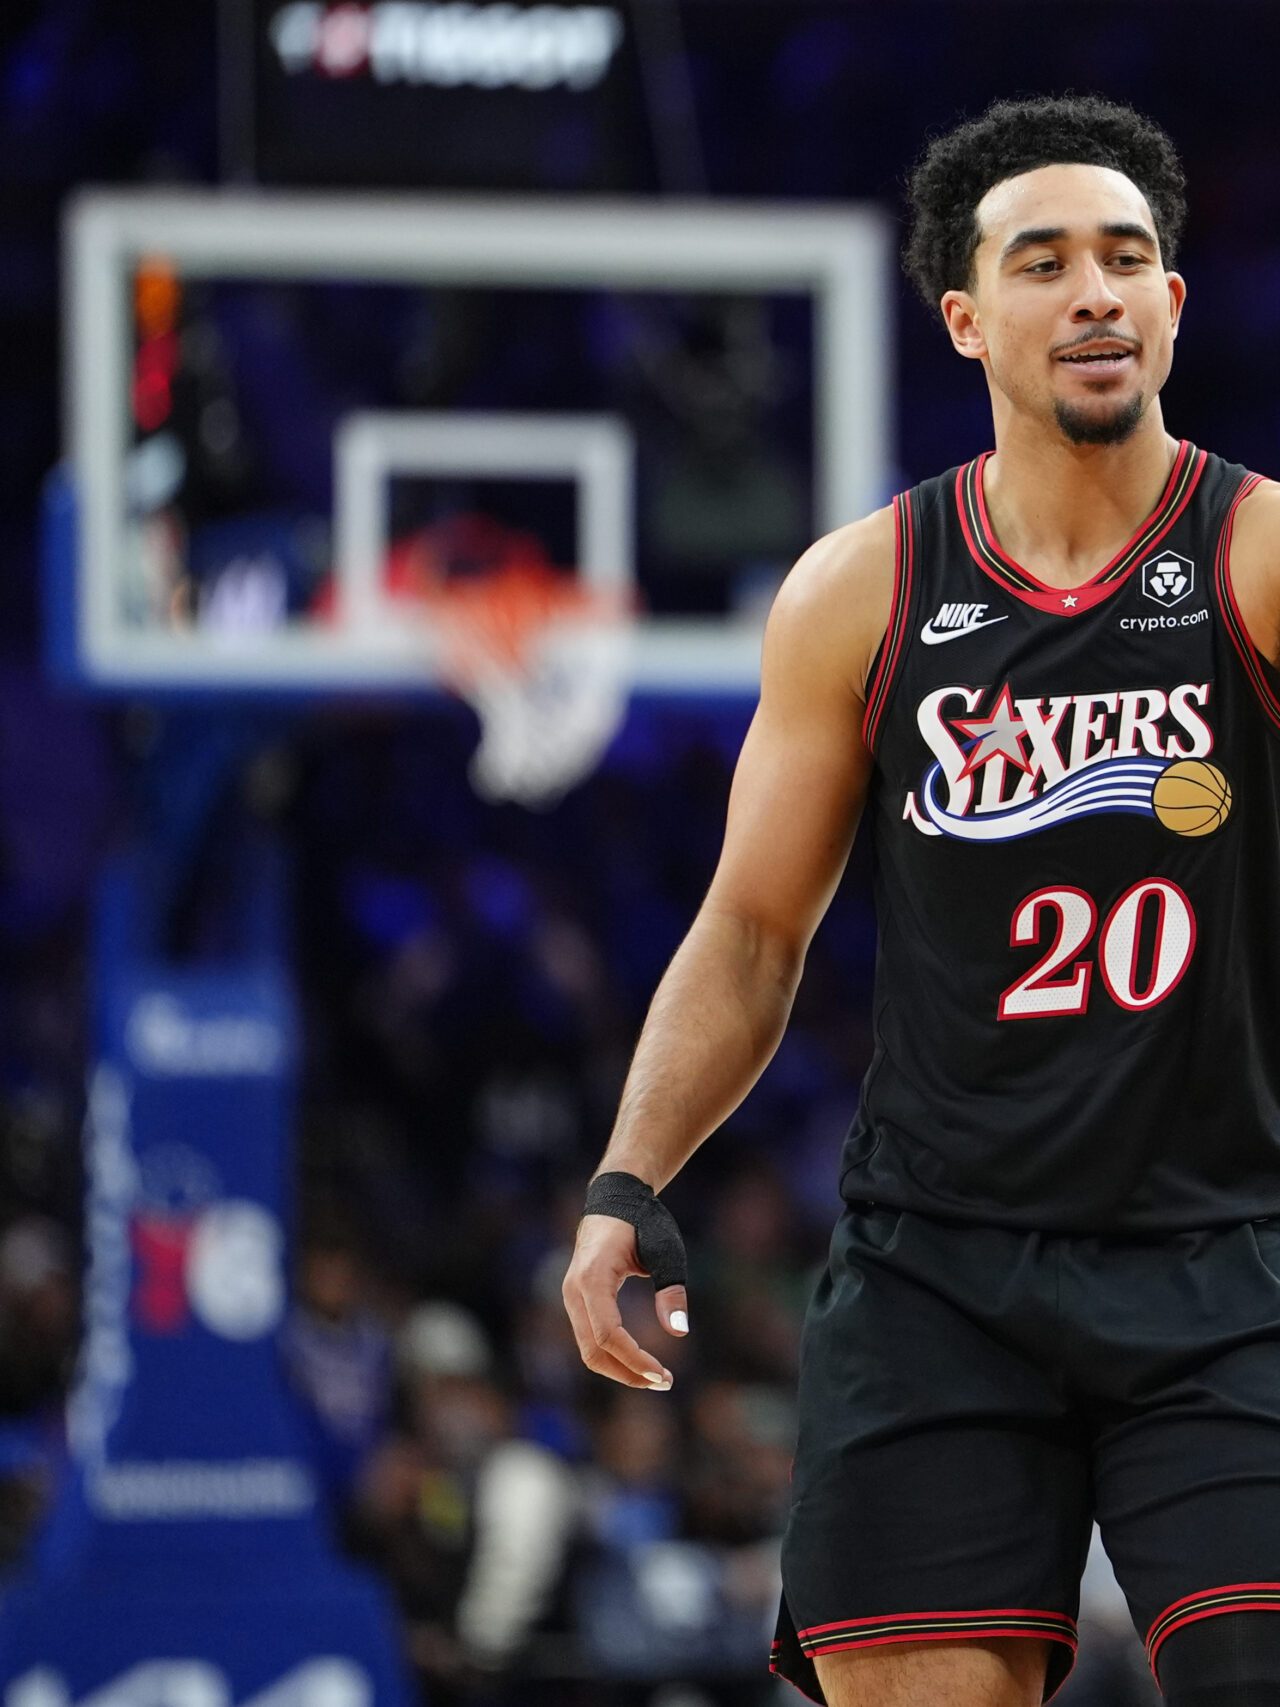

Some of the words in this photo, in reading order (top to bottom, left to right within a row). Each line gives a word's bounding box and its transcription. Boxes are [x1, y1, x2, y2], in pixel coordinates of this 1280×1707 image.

[931, 602, 990, 628] NIKE
[1119, 608, 1209, 632] crypto.com
[902, 682, 1214, 836] SIXERS
[997, 876, 1197, 1021] 20
